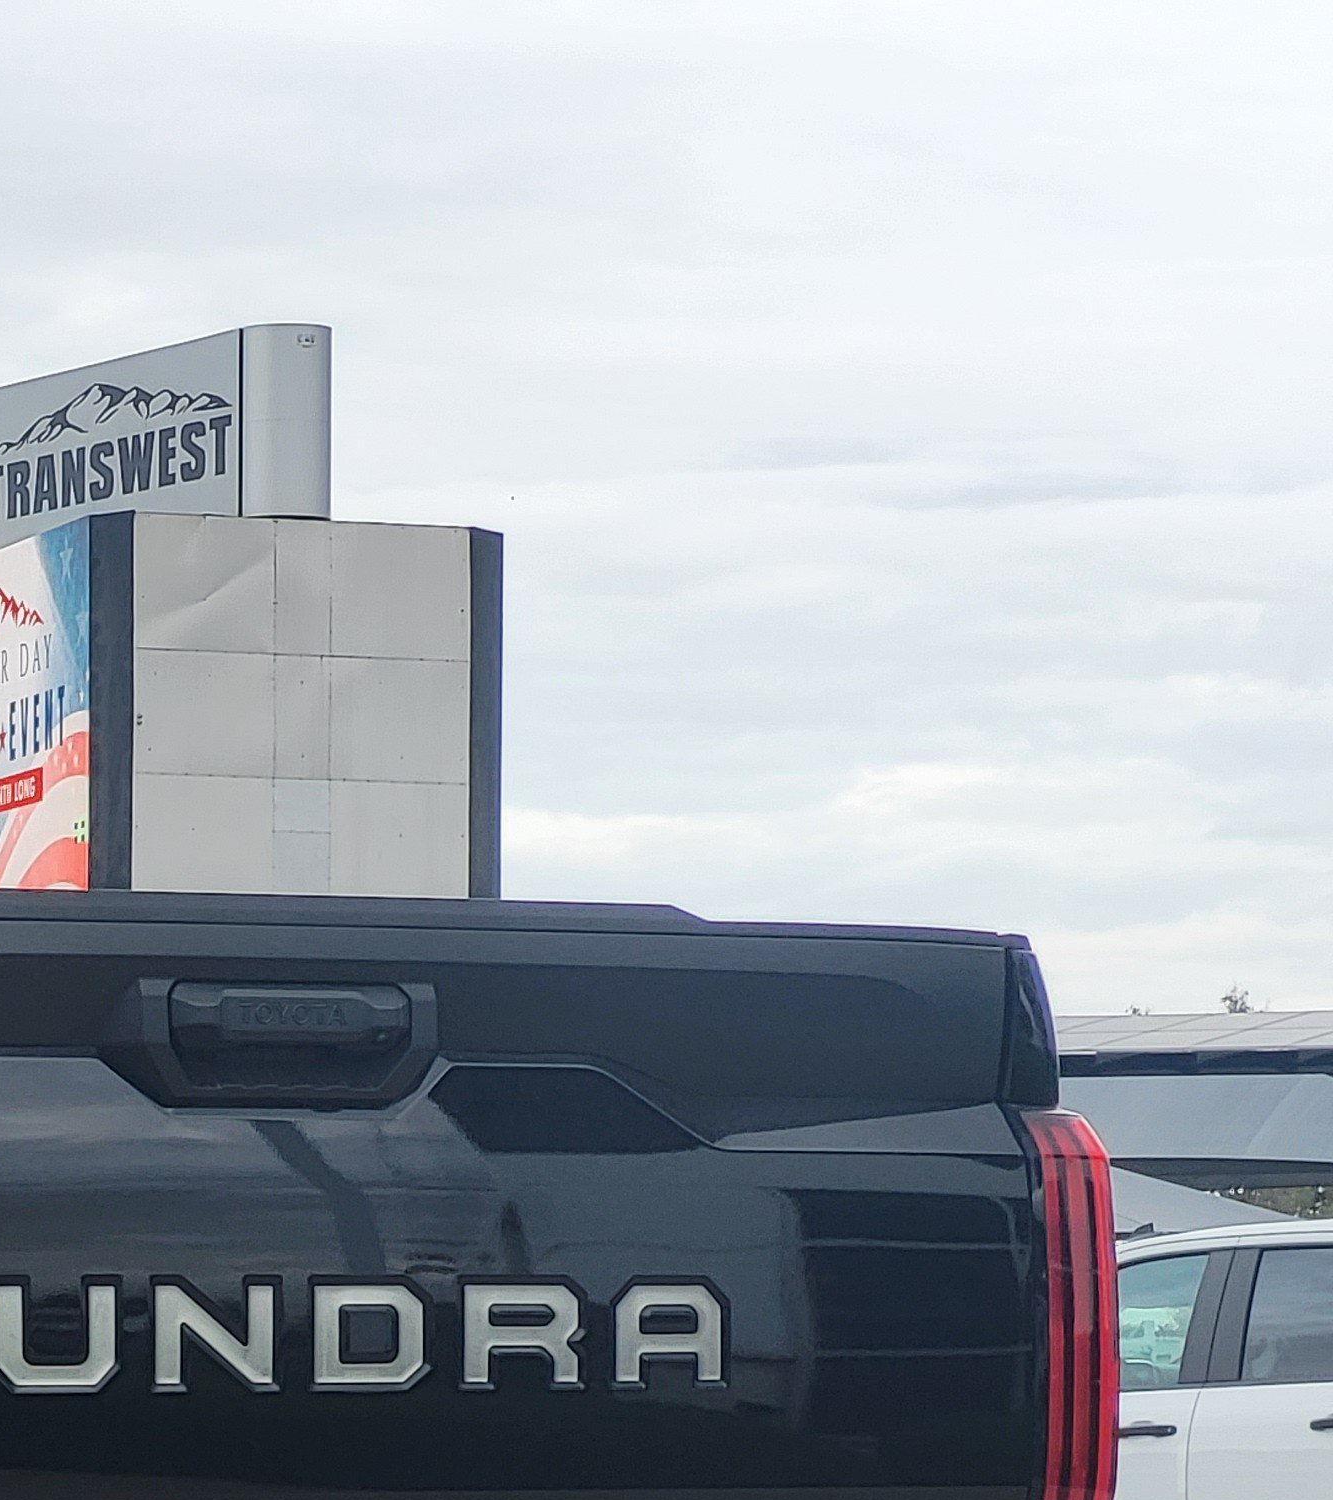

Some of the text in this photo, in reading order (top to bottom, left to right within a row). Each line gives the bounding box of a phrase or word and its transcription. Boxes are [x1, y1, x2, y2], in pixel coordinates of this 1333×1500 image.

[20, 633, 53, 678] DAY
[9, 684, 66, 761] EVENT
[14, 775, 36, 802] LONG
[238, 1001, 348, 1026] TOYOTA
